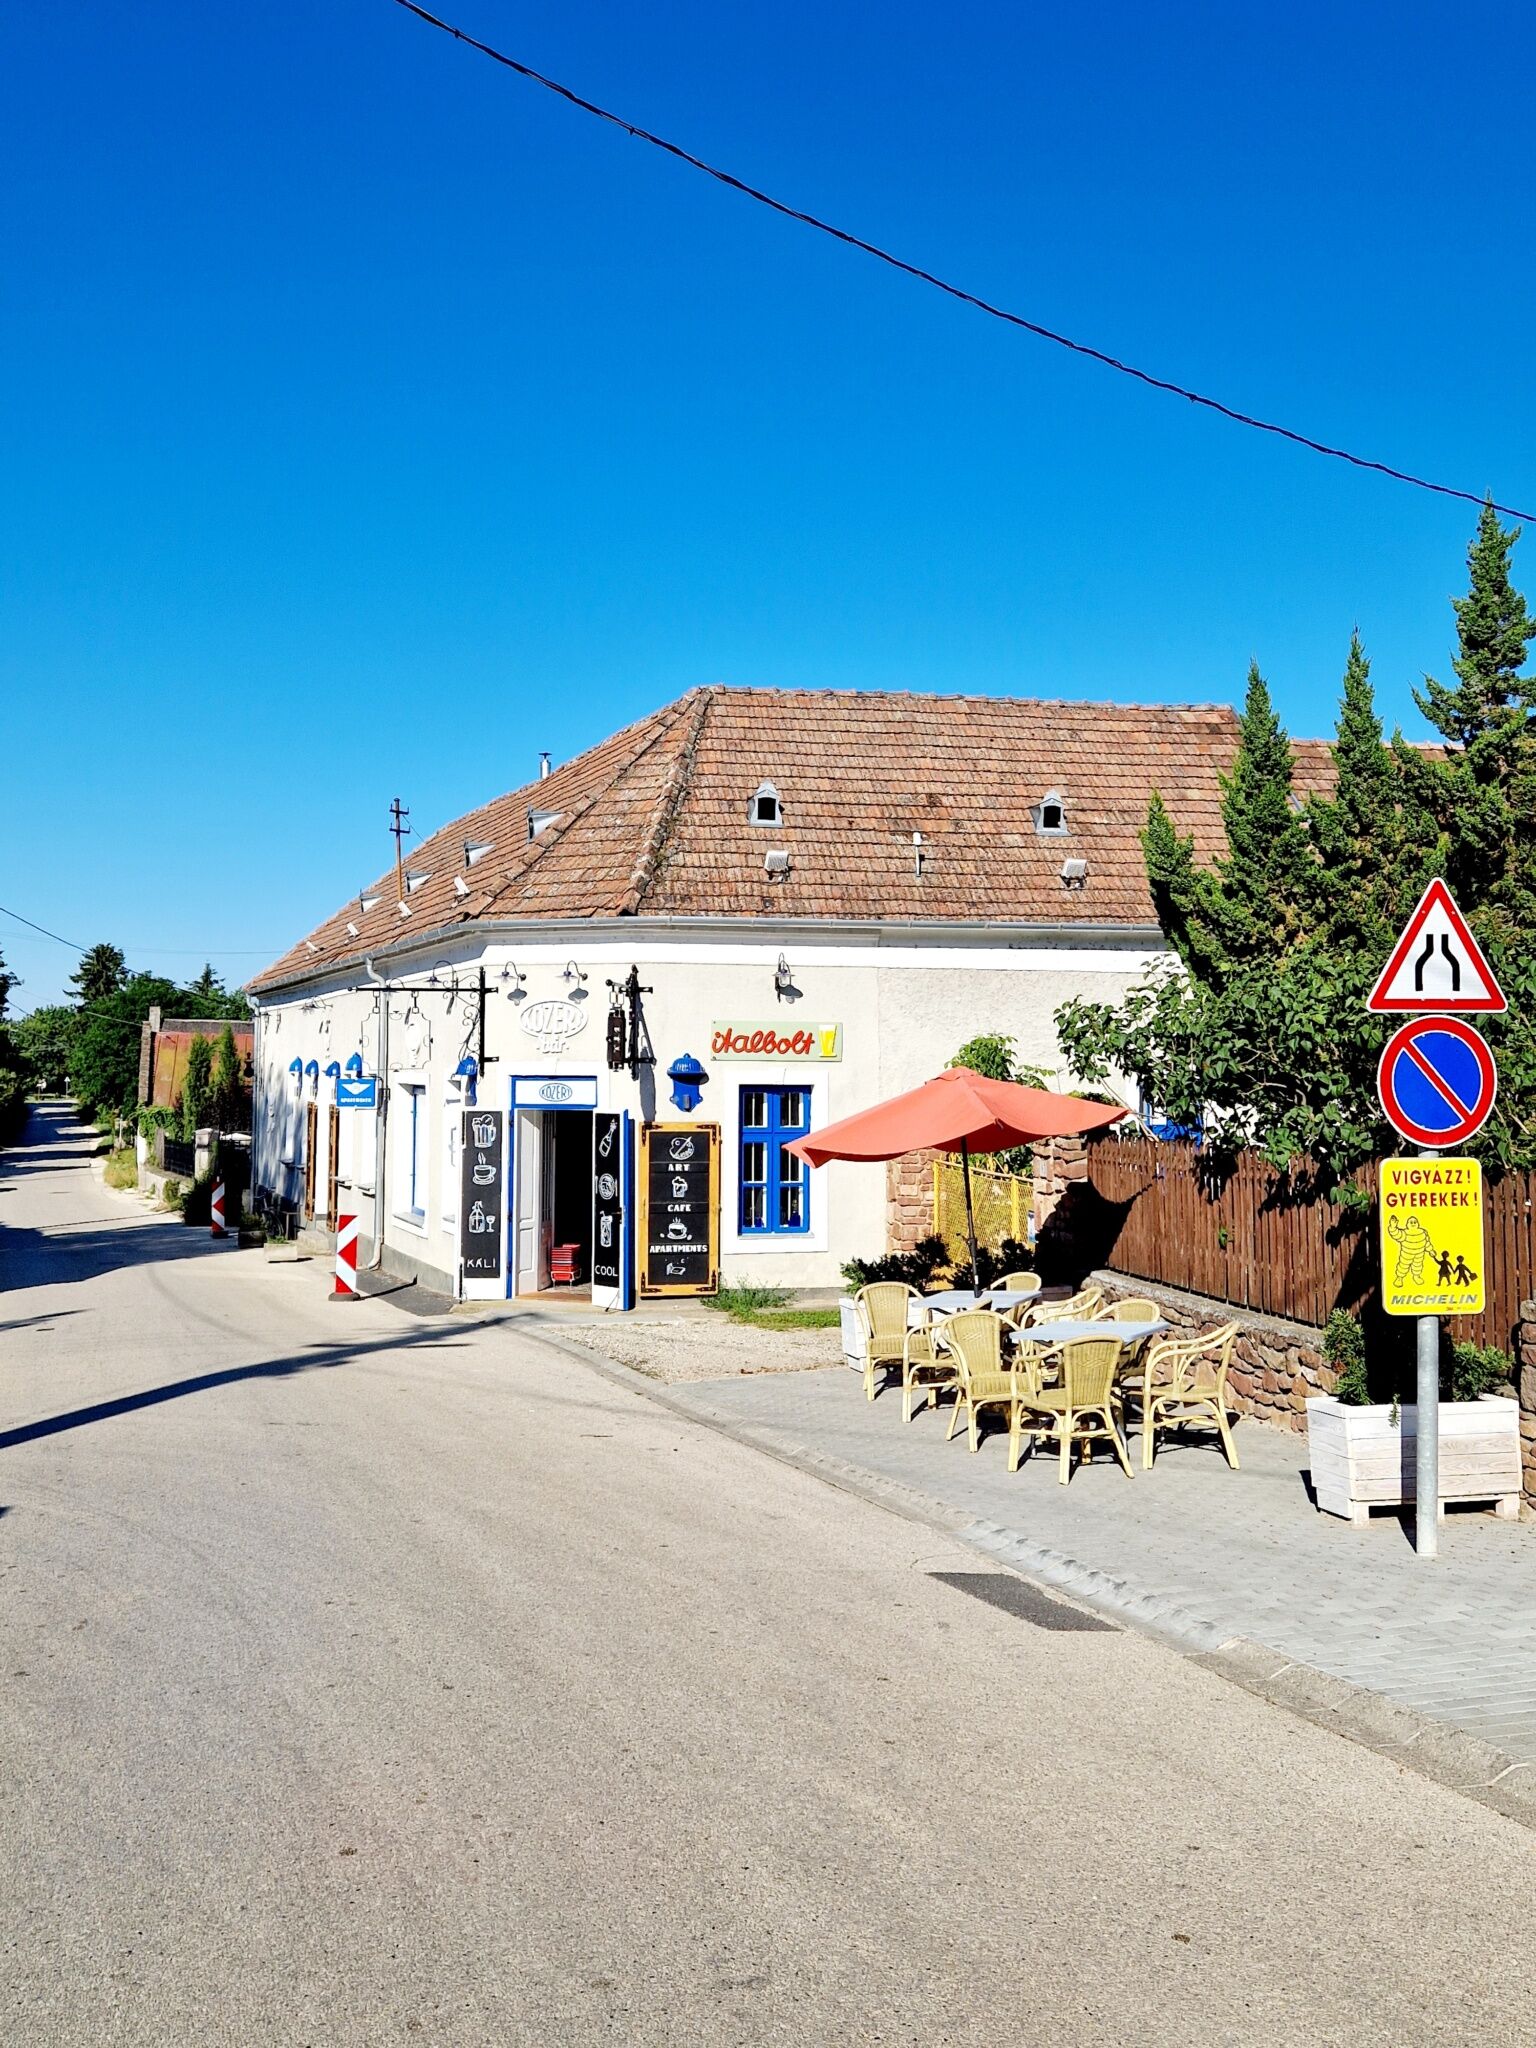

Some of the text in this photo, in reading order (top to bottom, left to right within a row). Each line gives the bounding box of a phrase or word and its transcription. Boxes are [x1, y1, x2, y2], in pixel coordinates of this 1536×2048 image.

[711, 1027, 815, 1055] italbolt
[667, 1163, 690, 1171] ART
[667, 1204, 691, 1213] CAFE
[649, 1244, 708, 1254] APARTMENTS
[594, 1264, 619, 1277] COOL
[1391, 1294, 1477, 1305] MICHELIN
